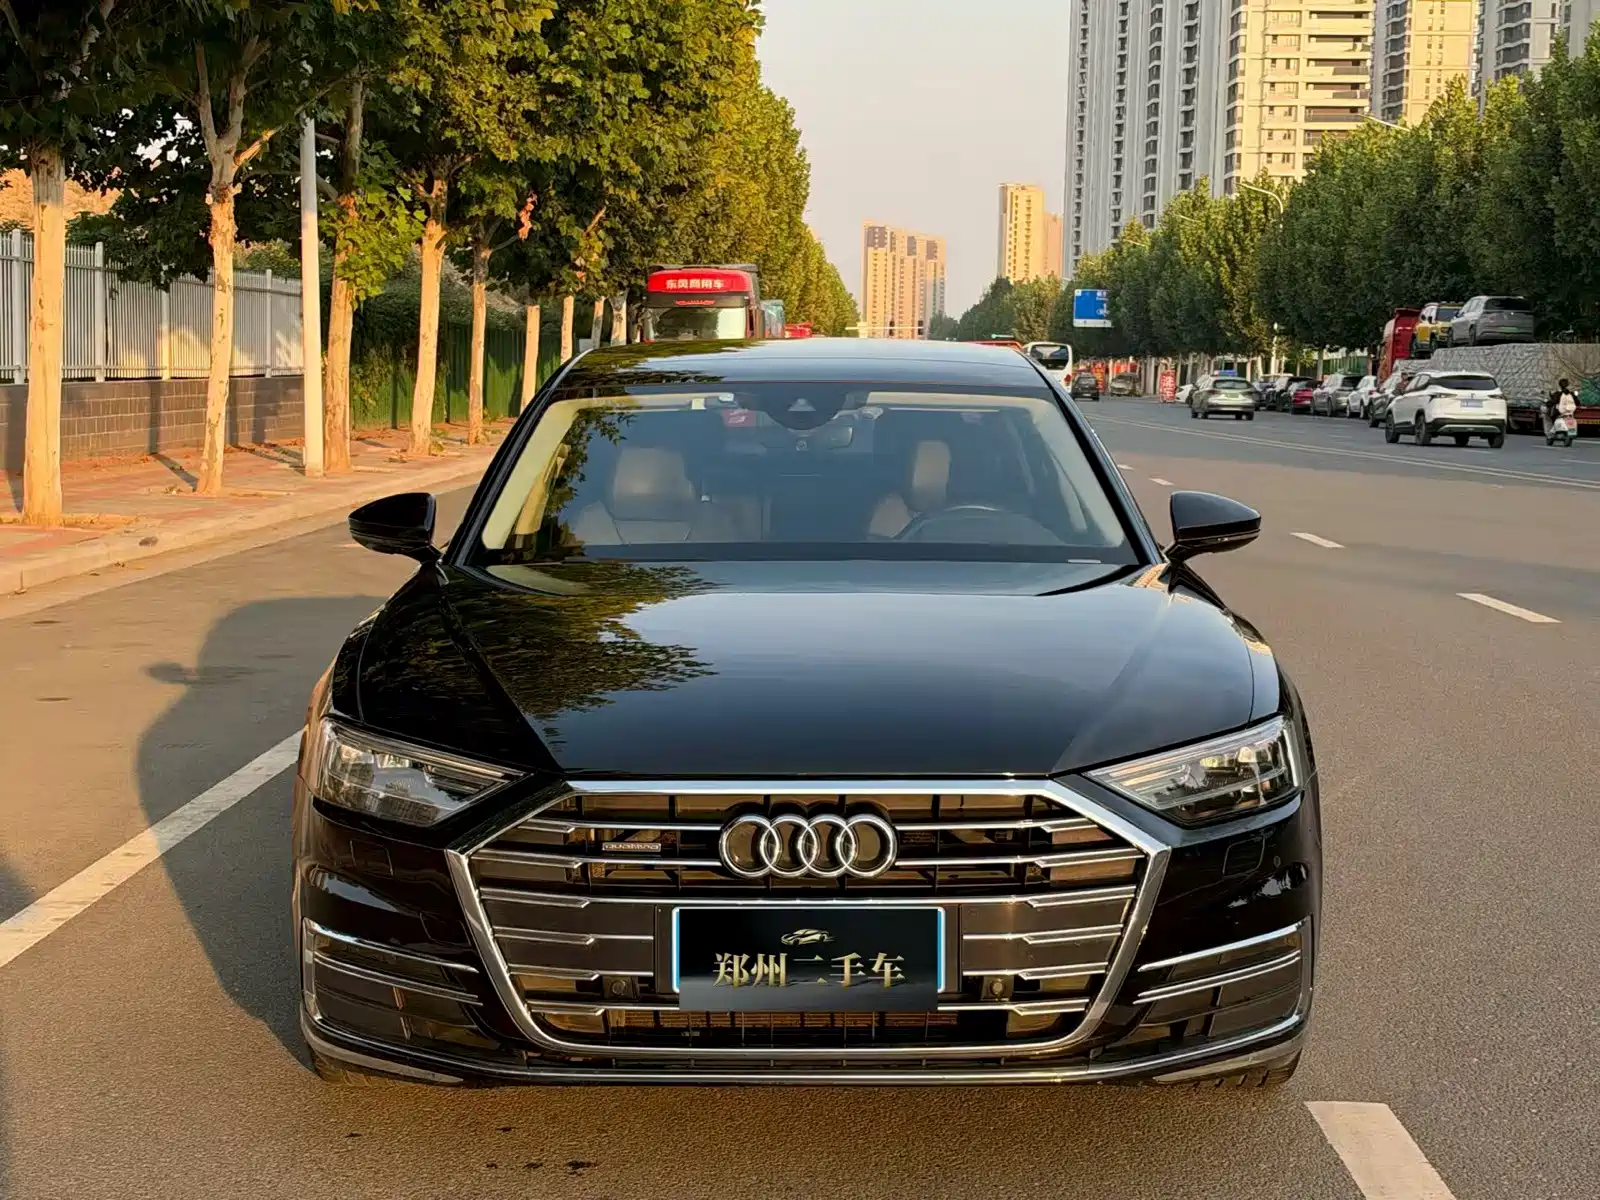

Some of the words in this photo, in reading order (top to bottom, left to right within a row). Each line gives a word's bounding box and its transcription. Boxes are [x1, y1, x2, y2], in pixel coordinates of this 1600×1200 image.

[666, 278, 724, 290] 东风商用车
